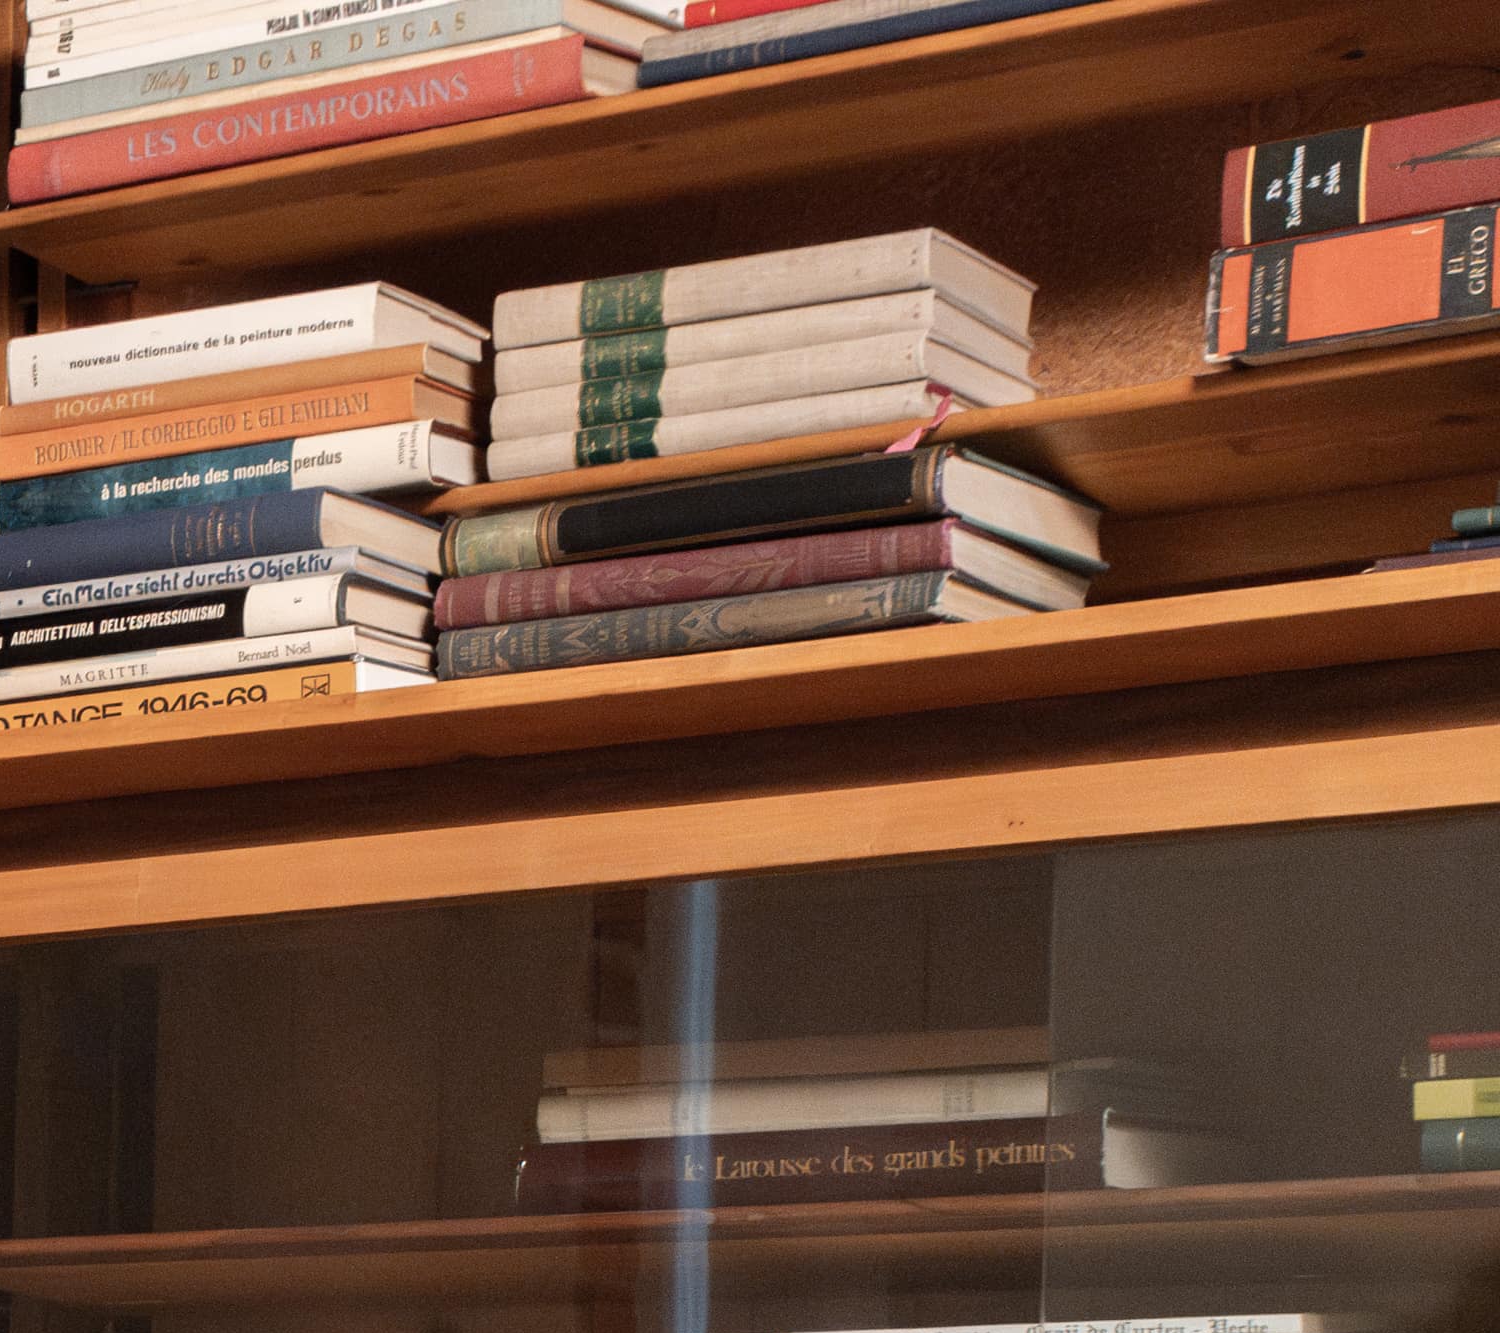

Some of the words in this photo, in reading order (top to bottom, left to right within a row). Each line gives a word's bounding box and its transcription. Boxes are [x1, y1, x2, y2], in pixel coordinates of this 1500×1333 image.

[205, 39, 323, 81] EDGAR
[348, 11, 467, 53] DEGAS
[128, 127, 177, 162] LES
[192, 71, 469, 149] CONTEMPORAINS
[1446, 255, 1466, 277] EL
[1467, 224, 1491, 297] GRECO
[69, 354, 121, 371] nouveau
[125, 341, 200, 362] dictionnaire
[204, 336, 220, 349] de
[224, 333, 236, 346] la
[240, 326, 293, 345] peinture
[297, 317, 355, 335] moderne
[54, 390, 156, 420] HOGARTH
[35, 435, 105, 466] BODMER
[142, 414, 236, 444] CORREGGIO
[243, 411, 253, 431] E
[258, 405, 285, 428] GLI
[290, 392, 370, 424] EMILIANI
[114, 481, 127, 498] la
[130, 471, 201, 497] recherche
[204, 467, 230, 486] des
[233, 458, 289, 480] mondes
[293, 451, 343, 473] perdus
[248, 552, 333, 582] Objektiv
[11, 622, 95, 647] ARCHITETTURA
[99, 603, 226, 635] DELL'ESPRESSIONISMO
[60, 664, 149, 686] MAGRITTE
[238, 646, 279, 662] Bernard
[714, 1153, 822, 1181] Larousse
[830, 1145, 875, 1174] des
[883, 1139, 966, 1177] grands
[974, 1140, 1077, 1175] peintres
